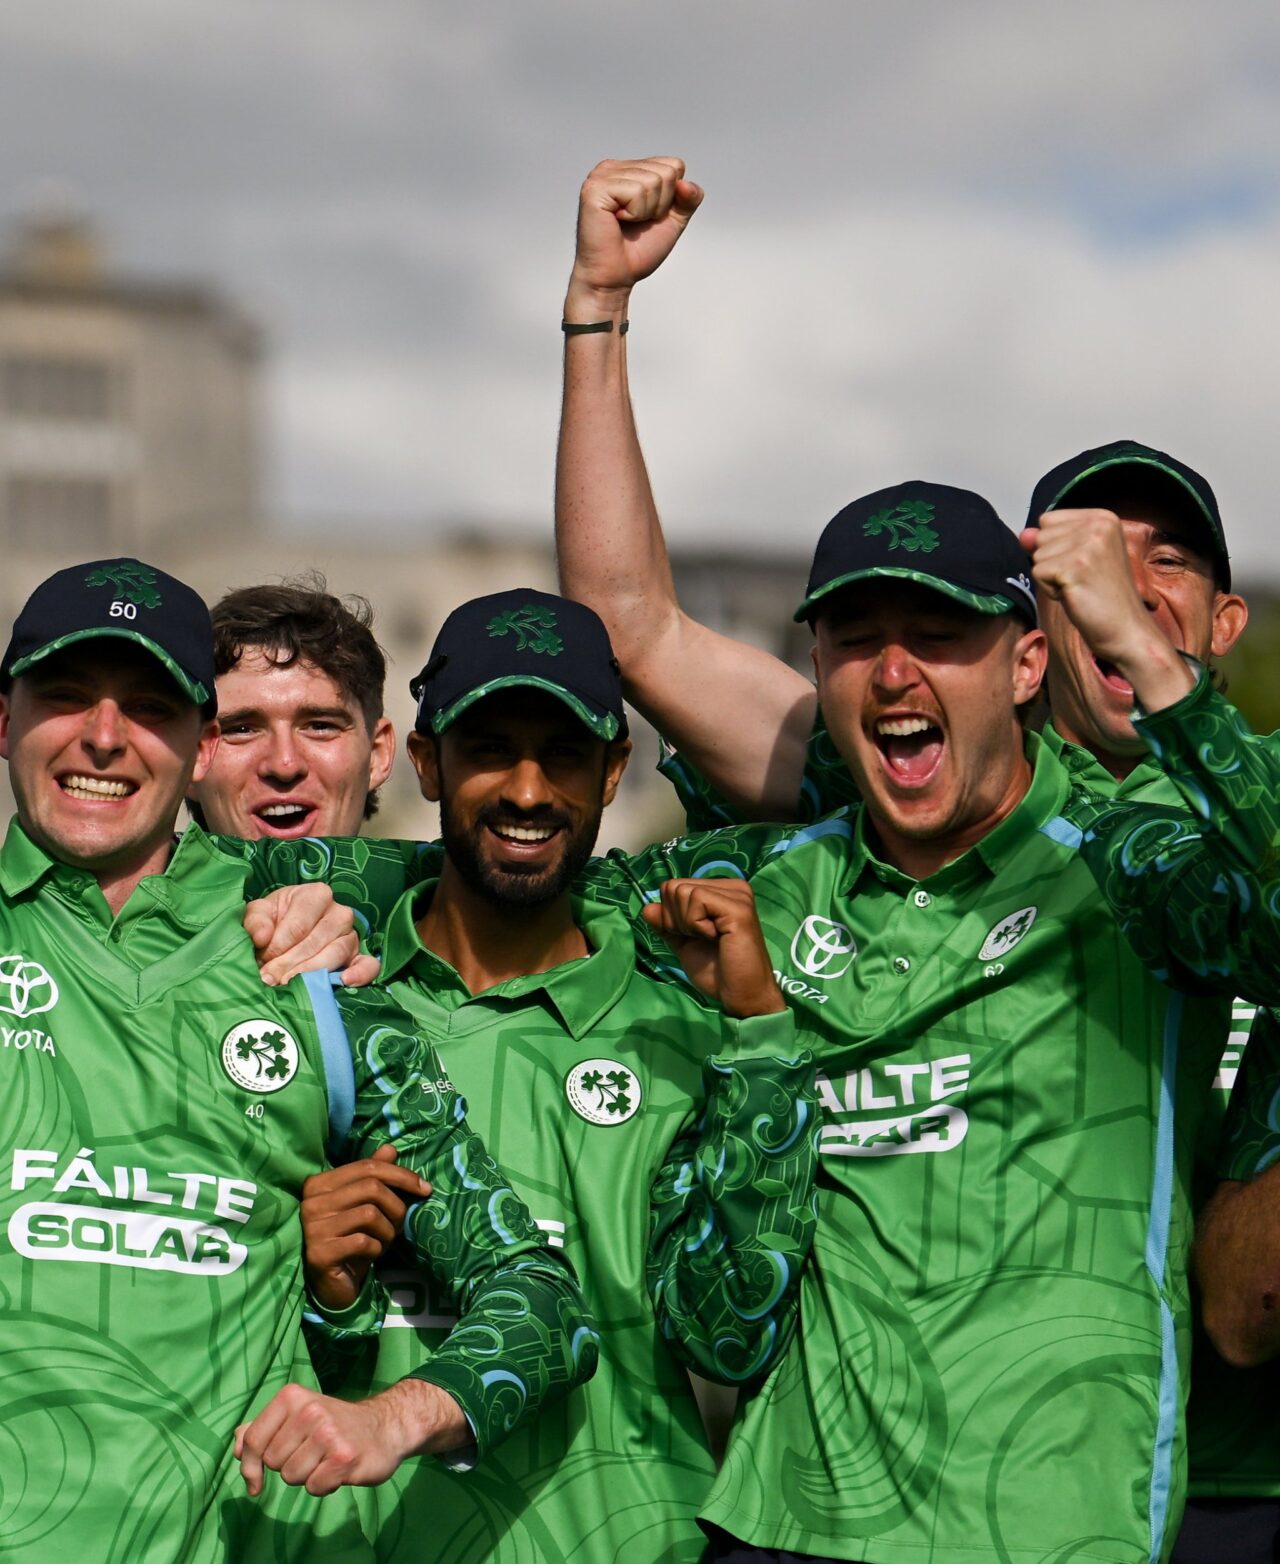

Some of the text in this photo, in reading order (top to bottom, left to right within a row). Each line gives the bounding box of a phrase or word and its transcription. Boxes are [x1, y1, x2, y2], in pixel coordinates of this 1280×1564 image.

[109, 601, 137, 620] 50
[773, 970, 830, 1004] YOTA
[245, 1104, 264, 1119] 40
[10, 1147, 257, 1224] FÁILTE
[27, 1214, 230, 1264] SOLAR
